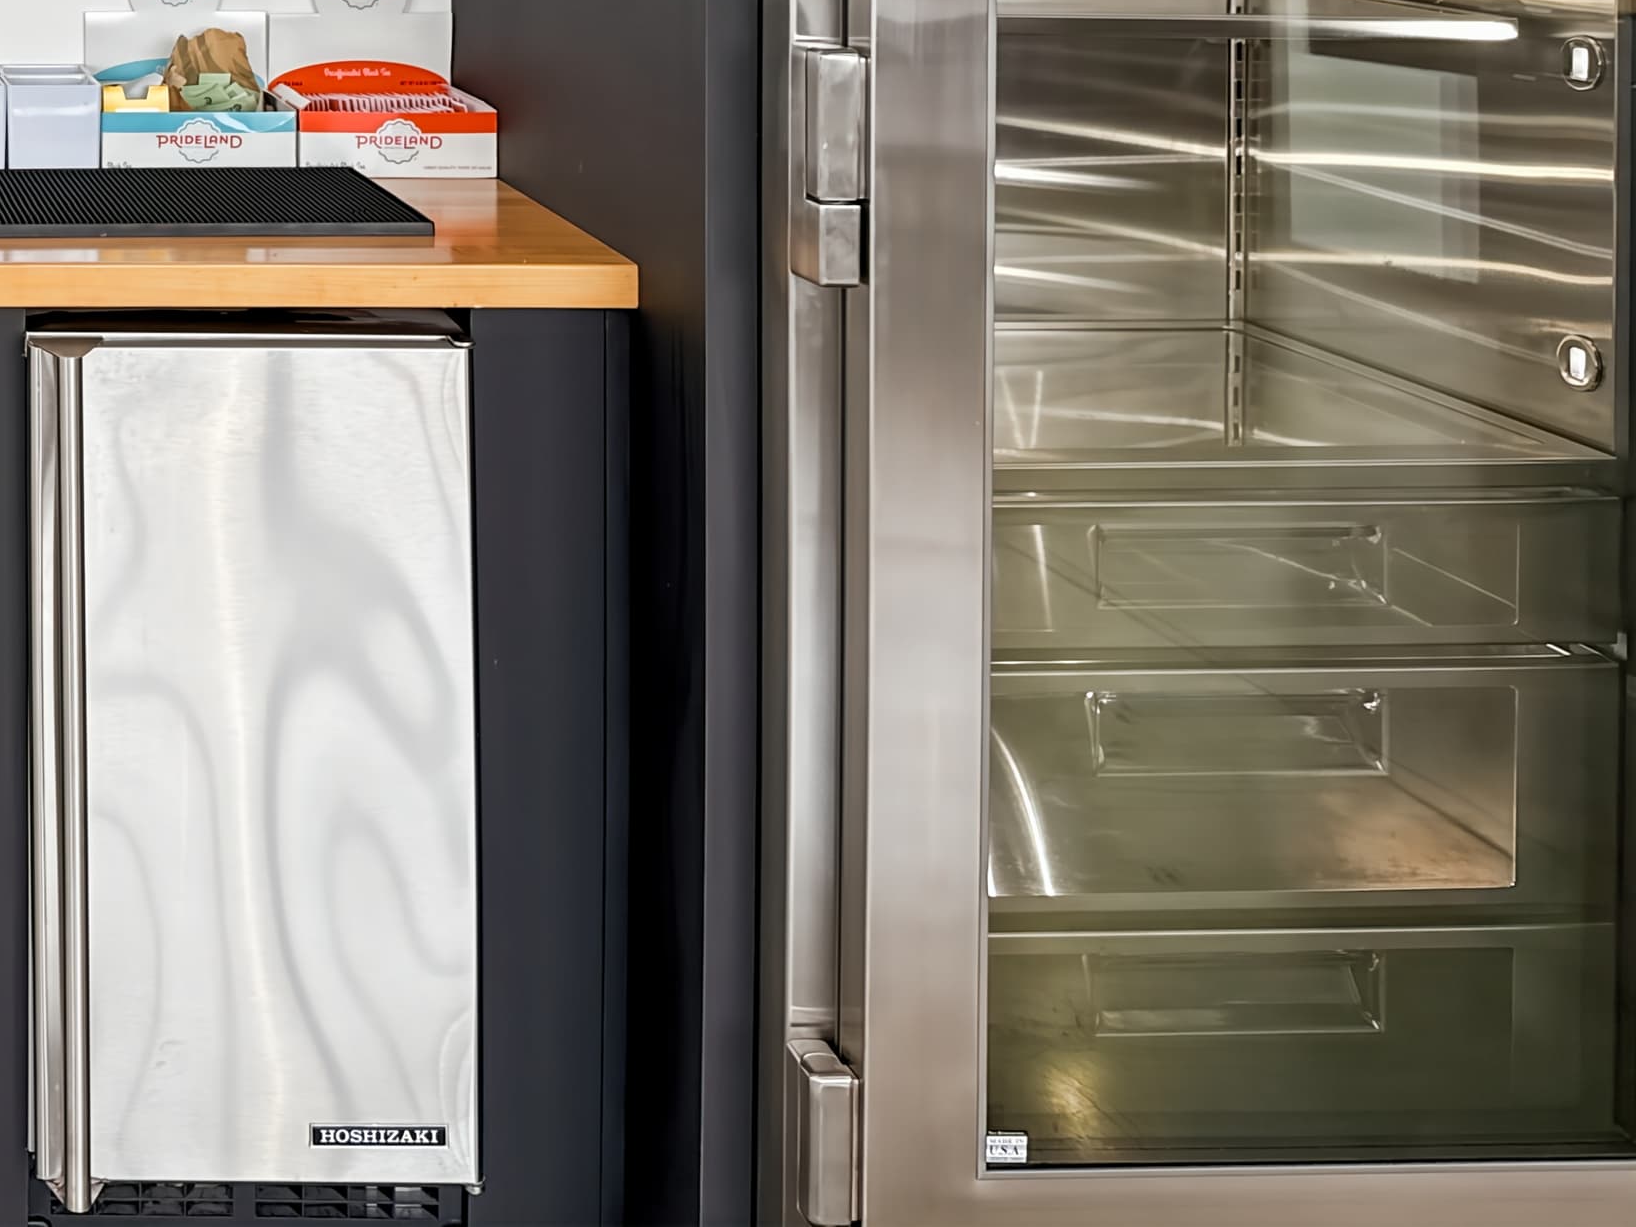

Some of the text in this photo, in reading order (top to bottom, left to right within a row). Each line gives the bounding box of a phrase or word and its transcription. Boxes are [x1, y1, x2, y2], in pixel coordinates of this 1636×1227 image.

[155, 135, 243, 150] PRIDELAND
[355, 135, 443, 150] PRIDELAND
[320, 1129, 439, 1144] HOSHIZAKI
